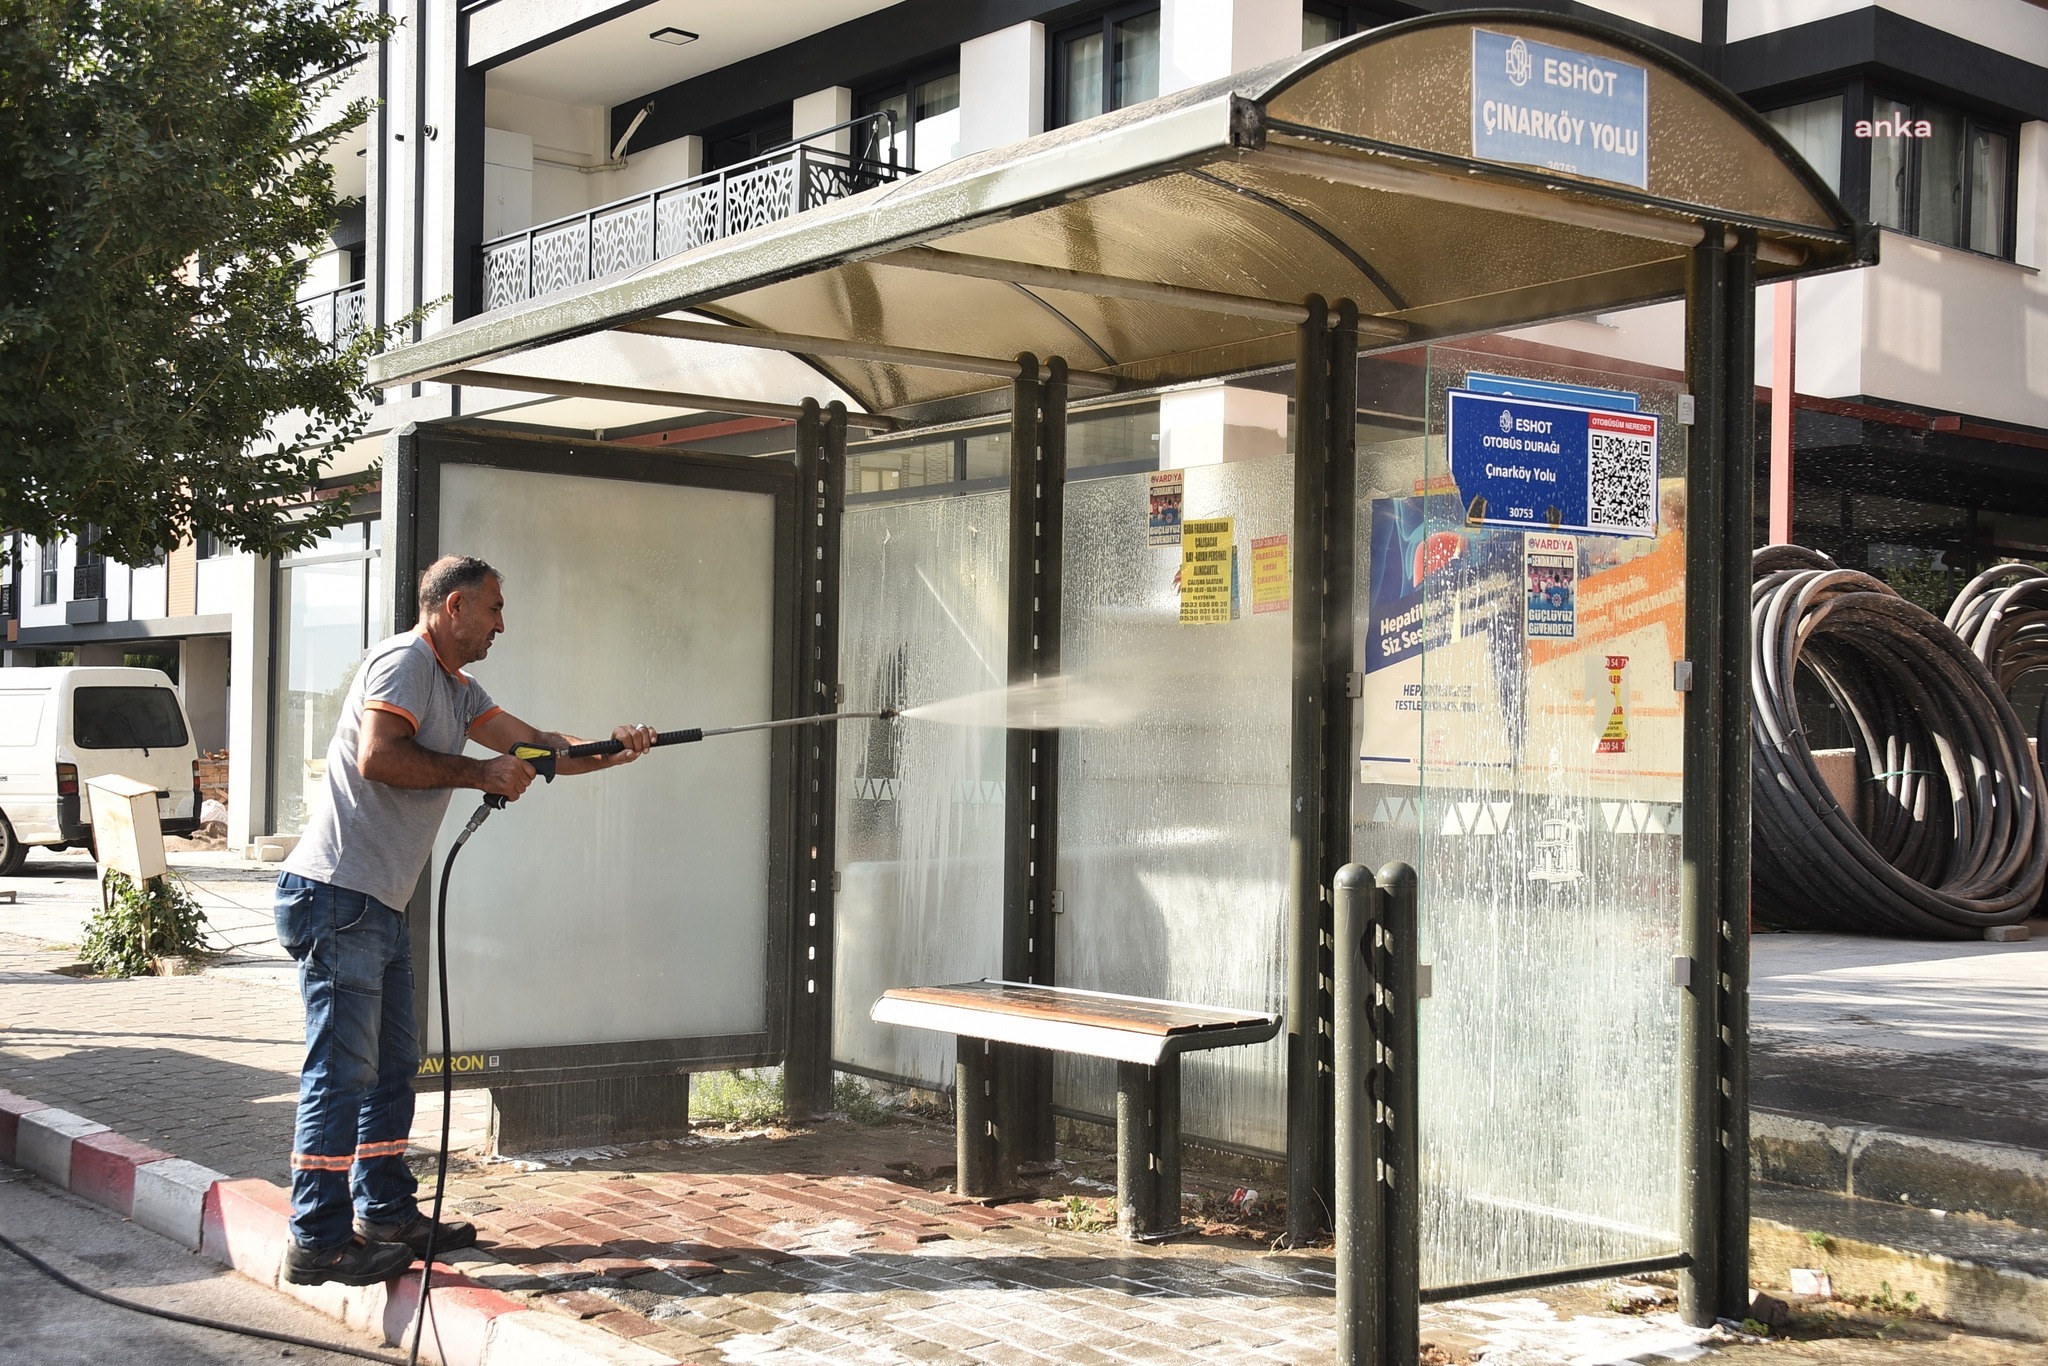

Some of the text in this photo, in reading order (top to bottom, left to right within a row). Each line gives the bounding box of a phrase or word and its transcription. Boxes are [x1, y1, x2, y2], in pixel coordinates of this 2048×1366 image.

[1544, 58, 1617, 97] ESHOT
[1483, 100, 1638, 157] ÇINARKÖY YOLU
[1515, 418, 1553, 434] ESHOT
[1591, 416, 1651, 432] OTOBÜSÜM NEREDE?
[1483, 435, 1560, 455] OTOBÜS DURAĞI
[1485, 463, 1557, 482] Çınarköy Yolu
[1509, 506, 1534, 519] 30753
[1381, 636, 1402, 657] Siz
